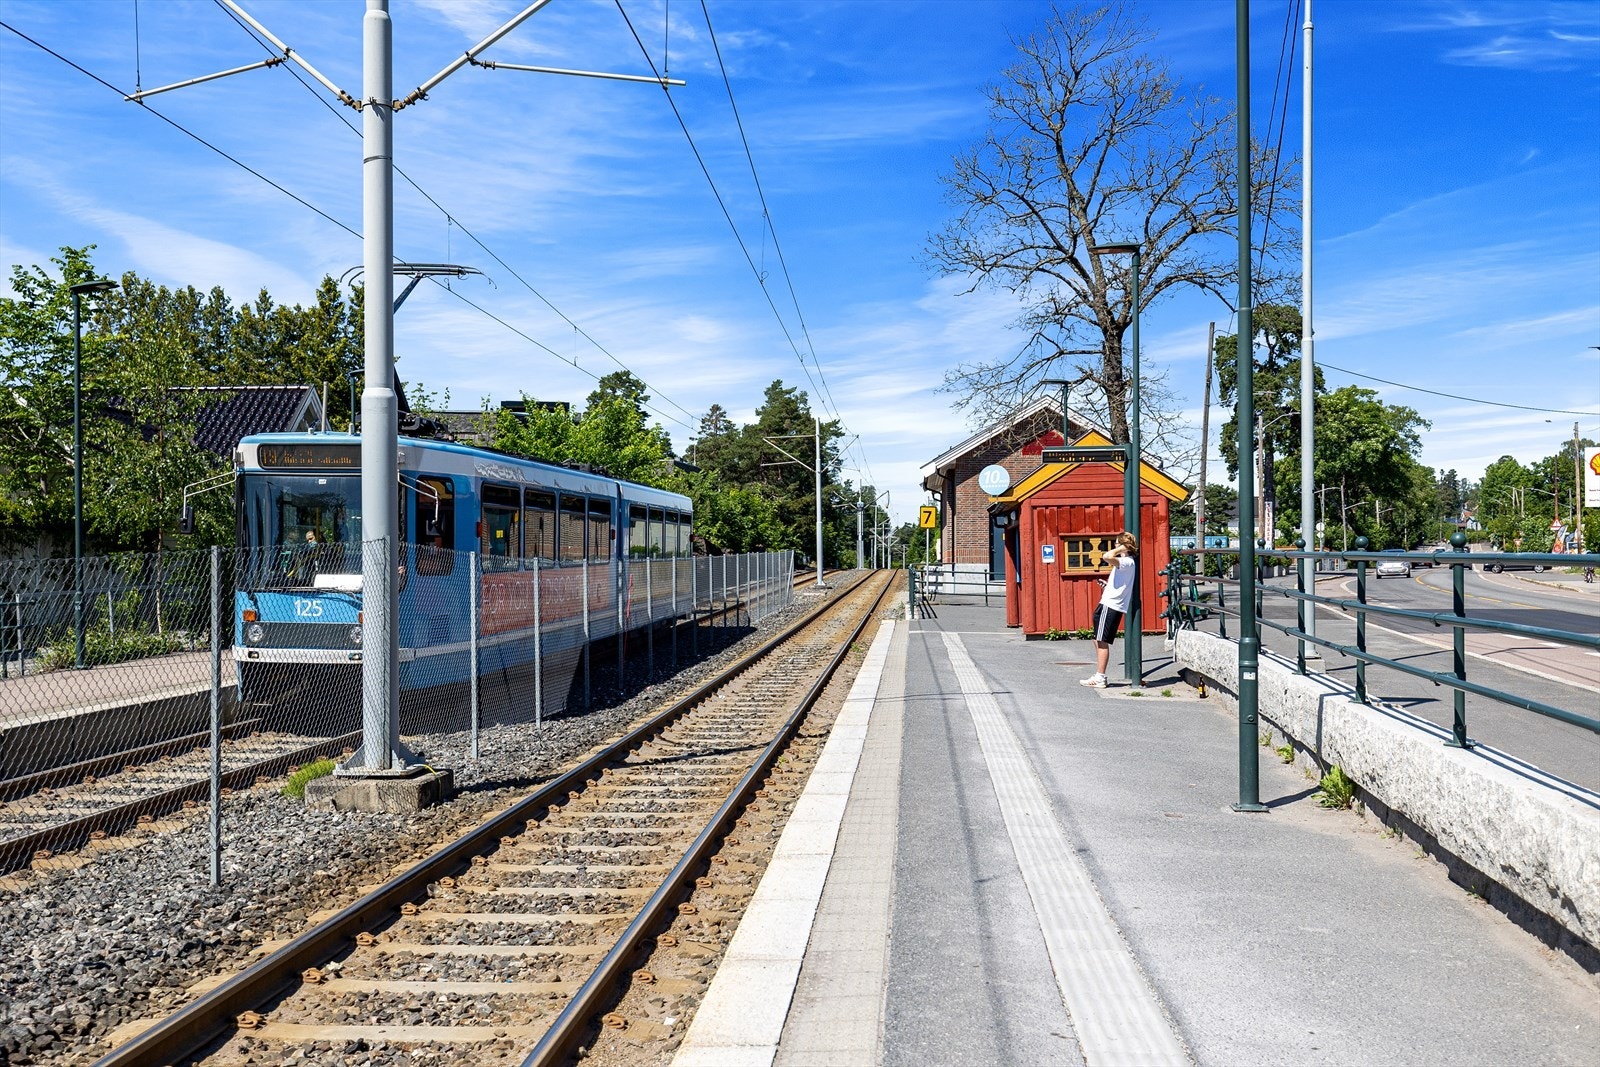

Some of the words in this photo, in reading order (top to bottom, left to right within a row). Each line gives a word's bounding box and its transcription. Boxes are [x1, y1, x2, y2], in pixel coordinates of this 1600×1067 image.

[984, 470, 1000, 484] 10
[923, 510, 932, 524] 7
[294, 599, 323, 617] 125
